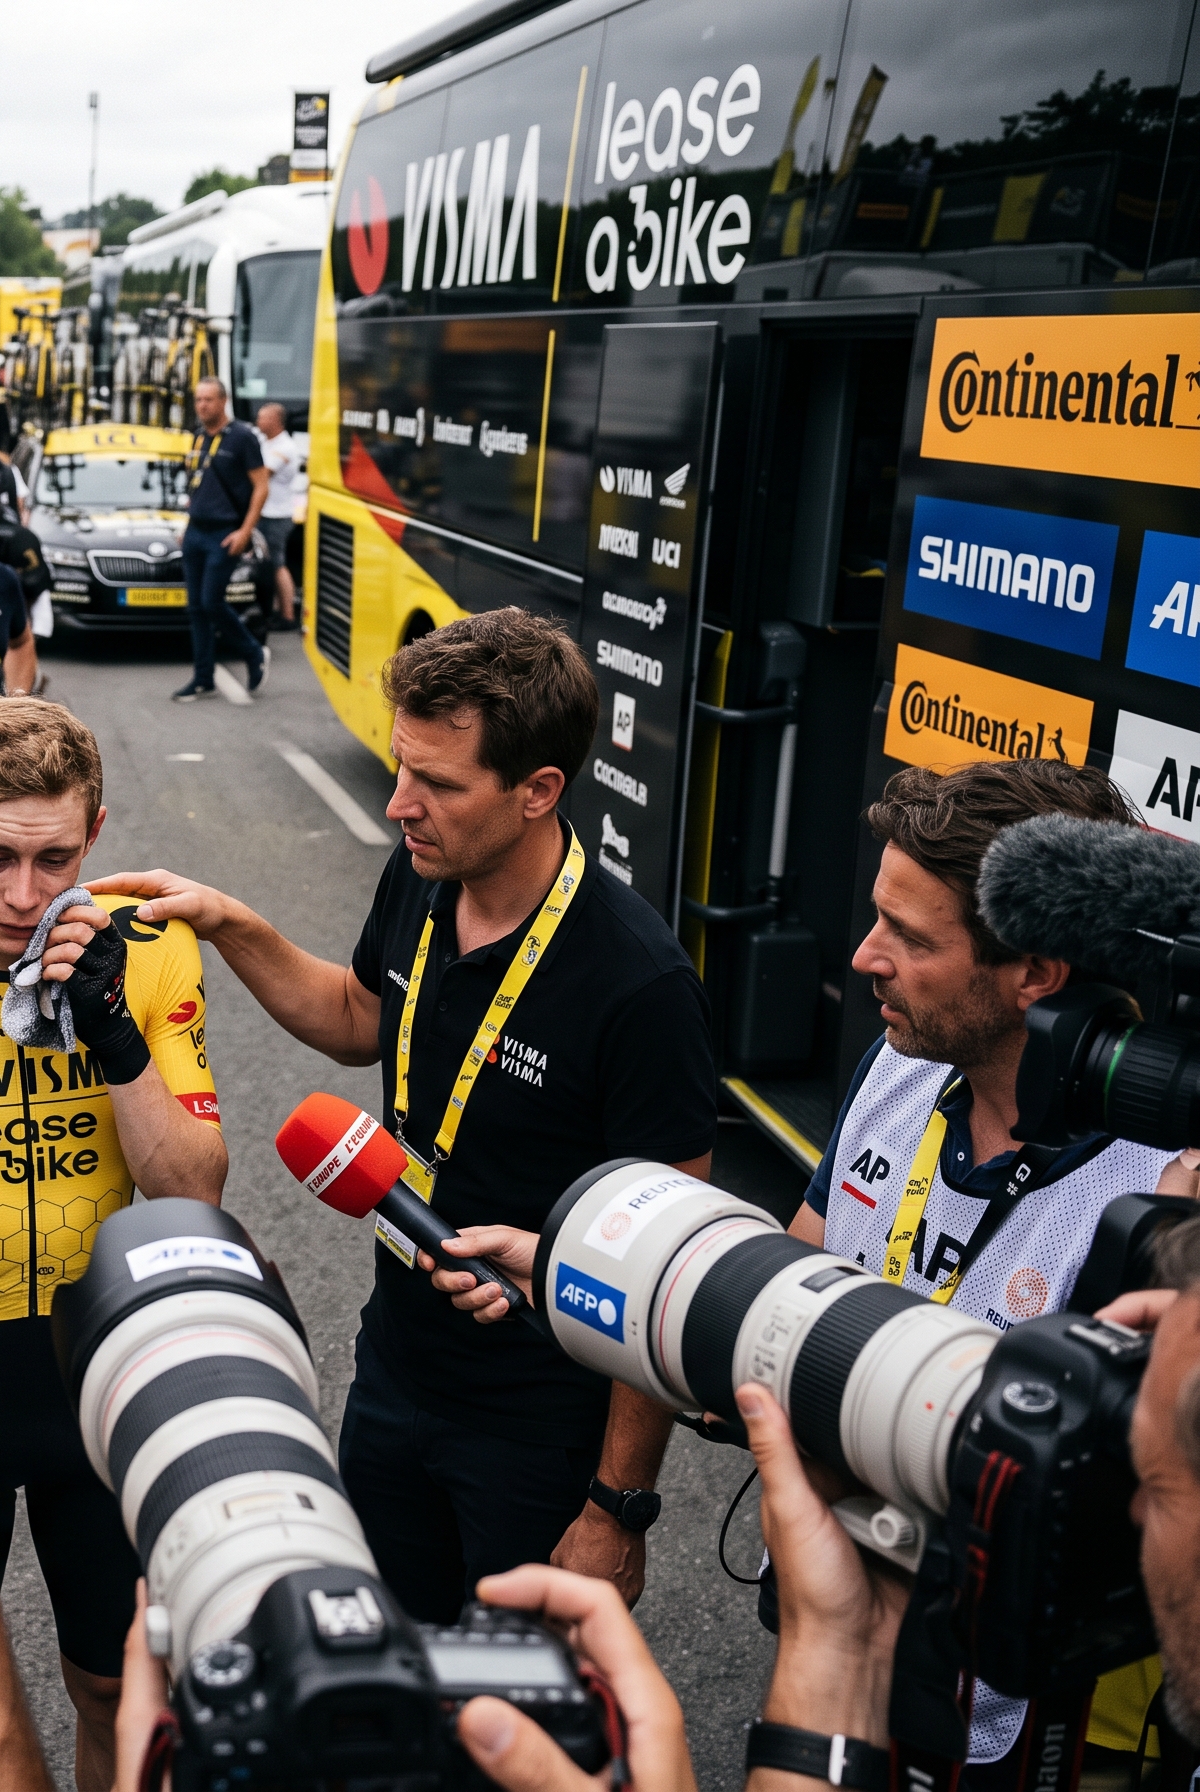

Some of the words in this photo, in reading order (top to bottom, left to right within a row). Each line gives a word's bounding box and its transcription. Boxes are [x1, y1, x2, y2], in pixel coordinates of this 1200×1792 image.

[595, 64, 761, 185] lease
[402, 124, 541, 293] VISMA
[585, 215, 620, 294] a
[627, 176, 751, 292] bike
[939, 349, 1181, 433] Continental
[652, 537, 681, 569] UCI
[918, 535, 1096, 613] SHIMANO
[596, 639, 663, 687] SHIMANO
[616, 709, 631, 733] AP
[501, 1054, 543, 1088] VISMA
[504, 1035, 548, 1071] VISMA
[849, 1148, 891, 1185] AP
[560, 1282, 599, 1313] AFP
